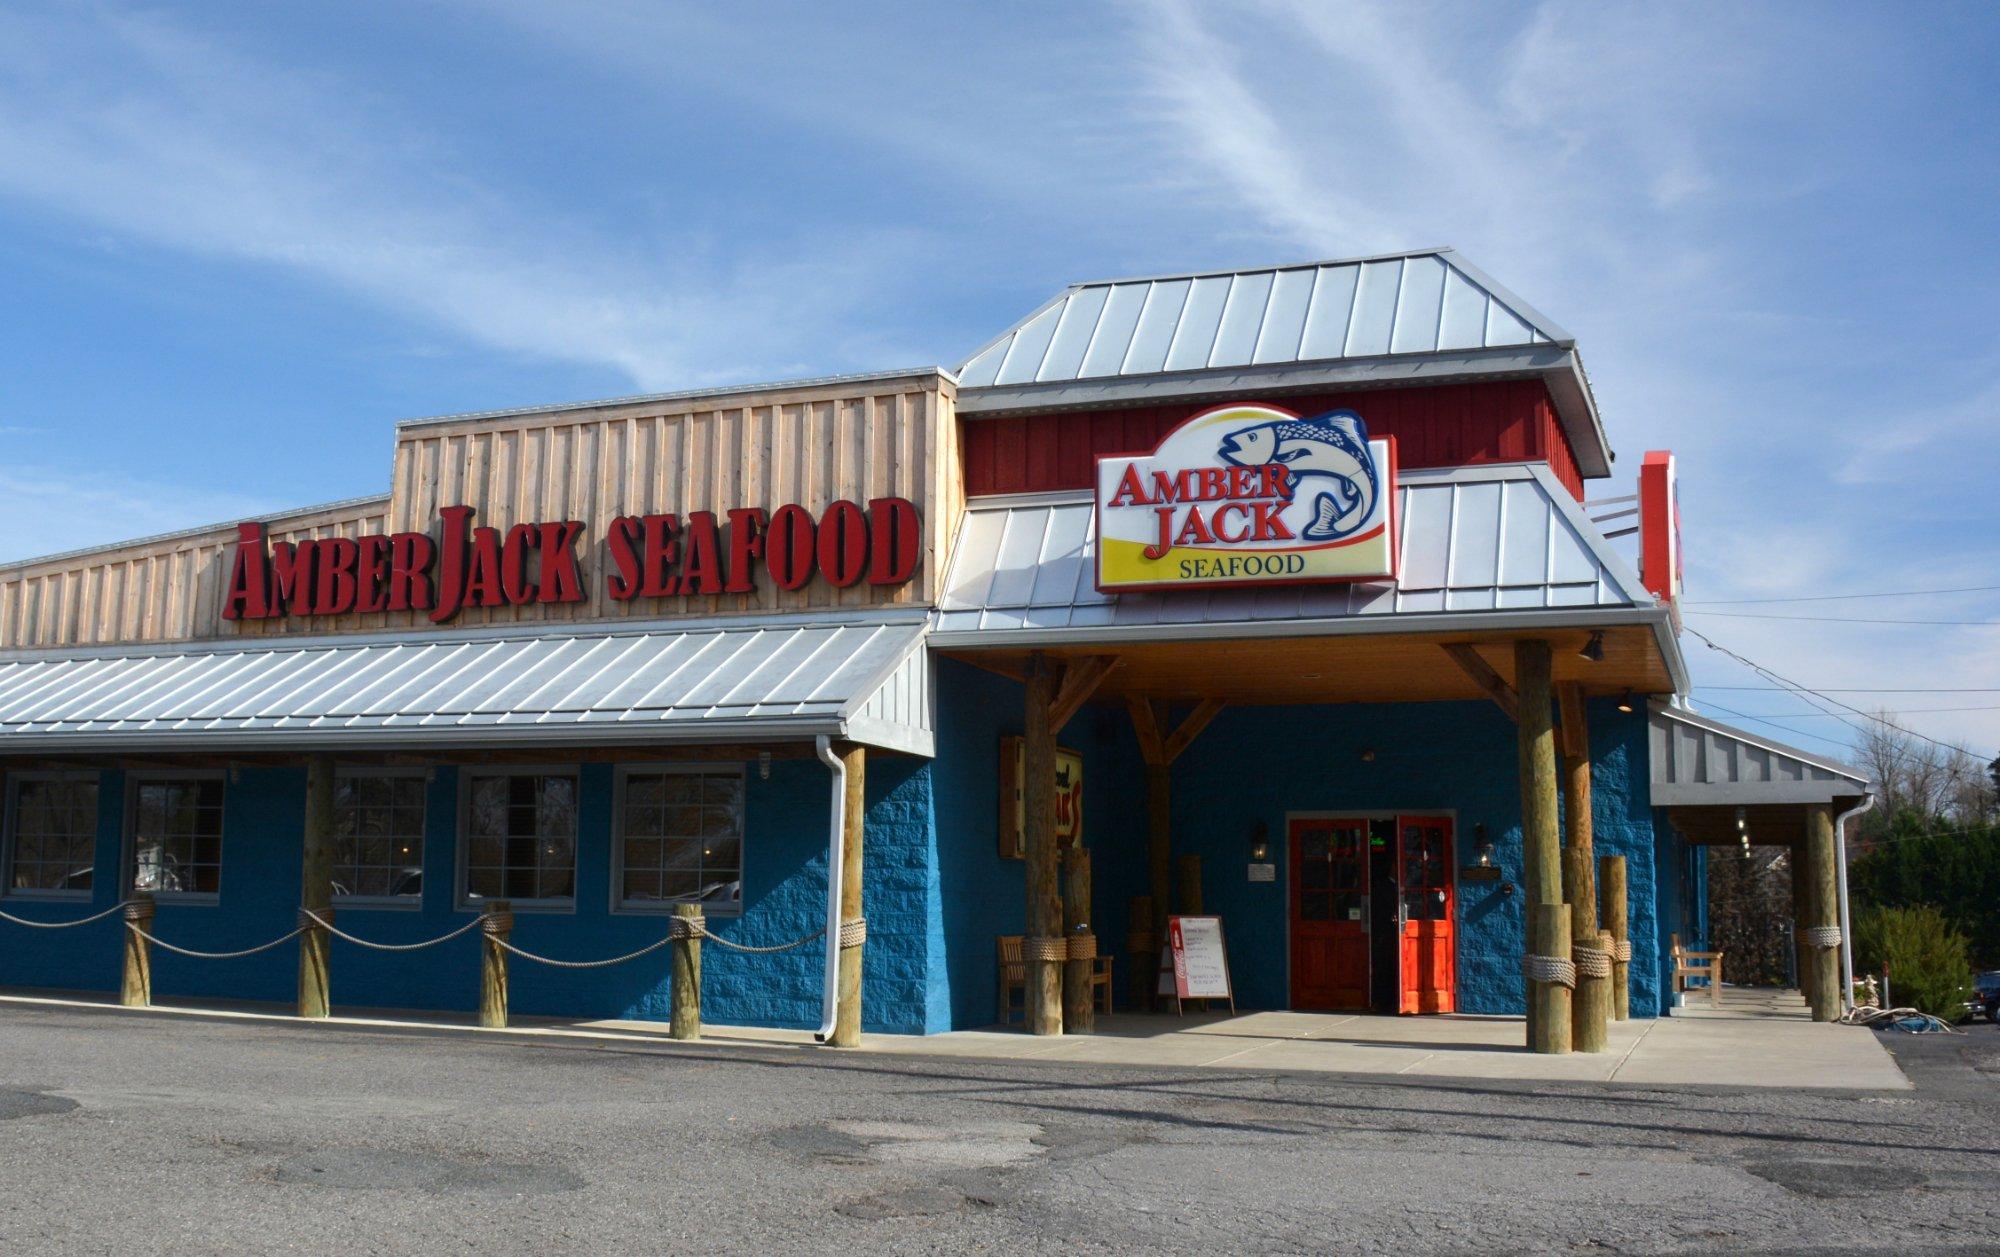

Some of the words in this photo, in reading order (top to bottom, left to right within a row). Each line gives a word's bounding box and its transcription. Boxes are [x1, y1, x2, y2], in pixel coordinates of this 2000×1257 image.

[1108, 463, 1294, 507] AMBER
[607, 497, 924, 601] SEAFOOD
[1143, 500, 1296, 560] JACK
[1180, 554, 1305, 579] SEAFOOD
